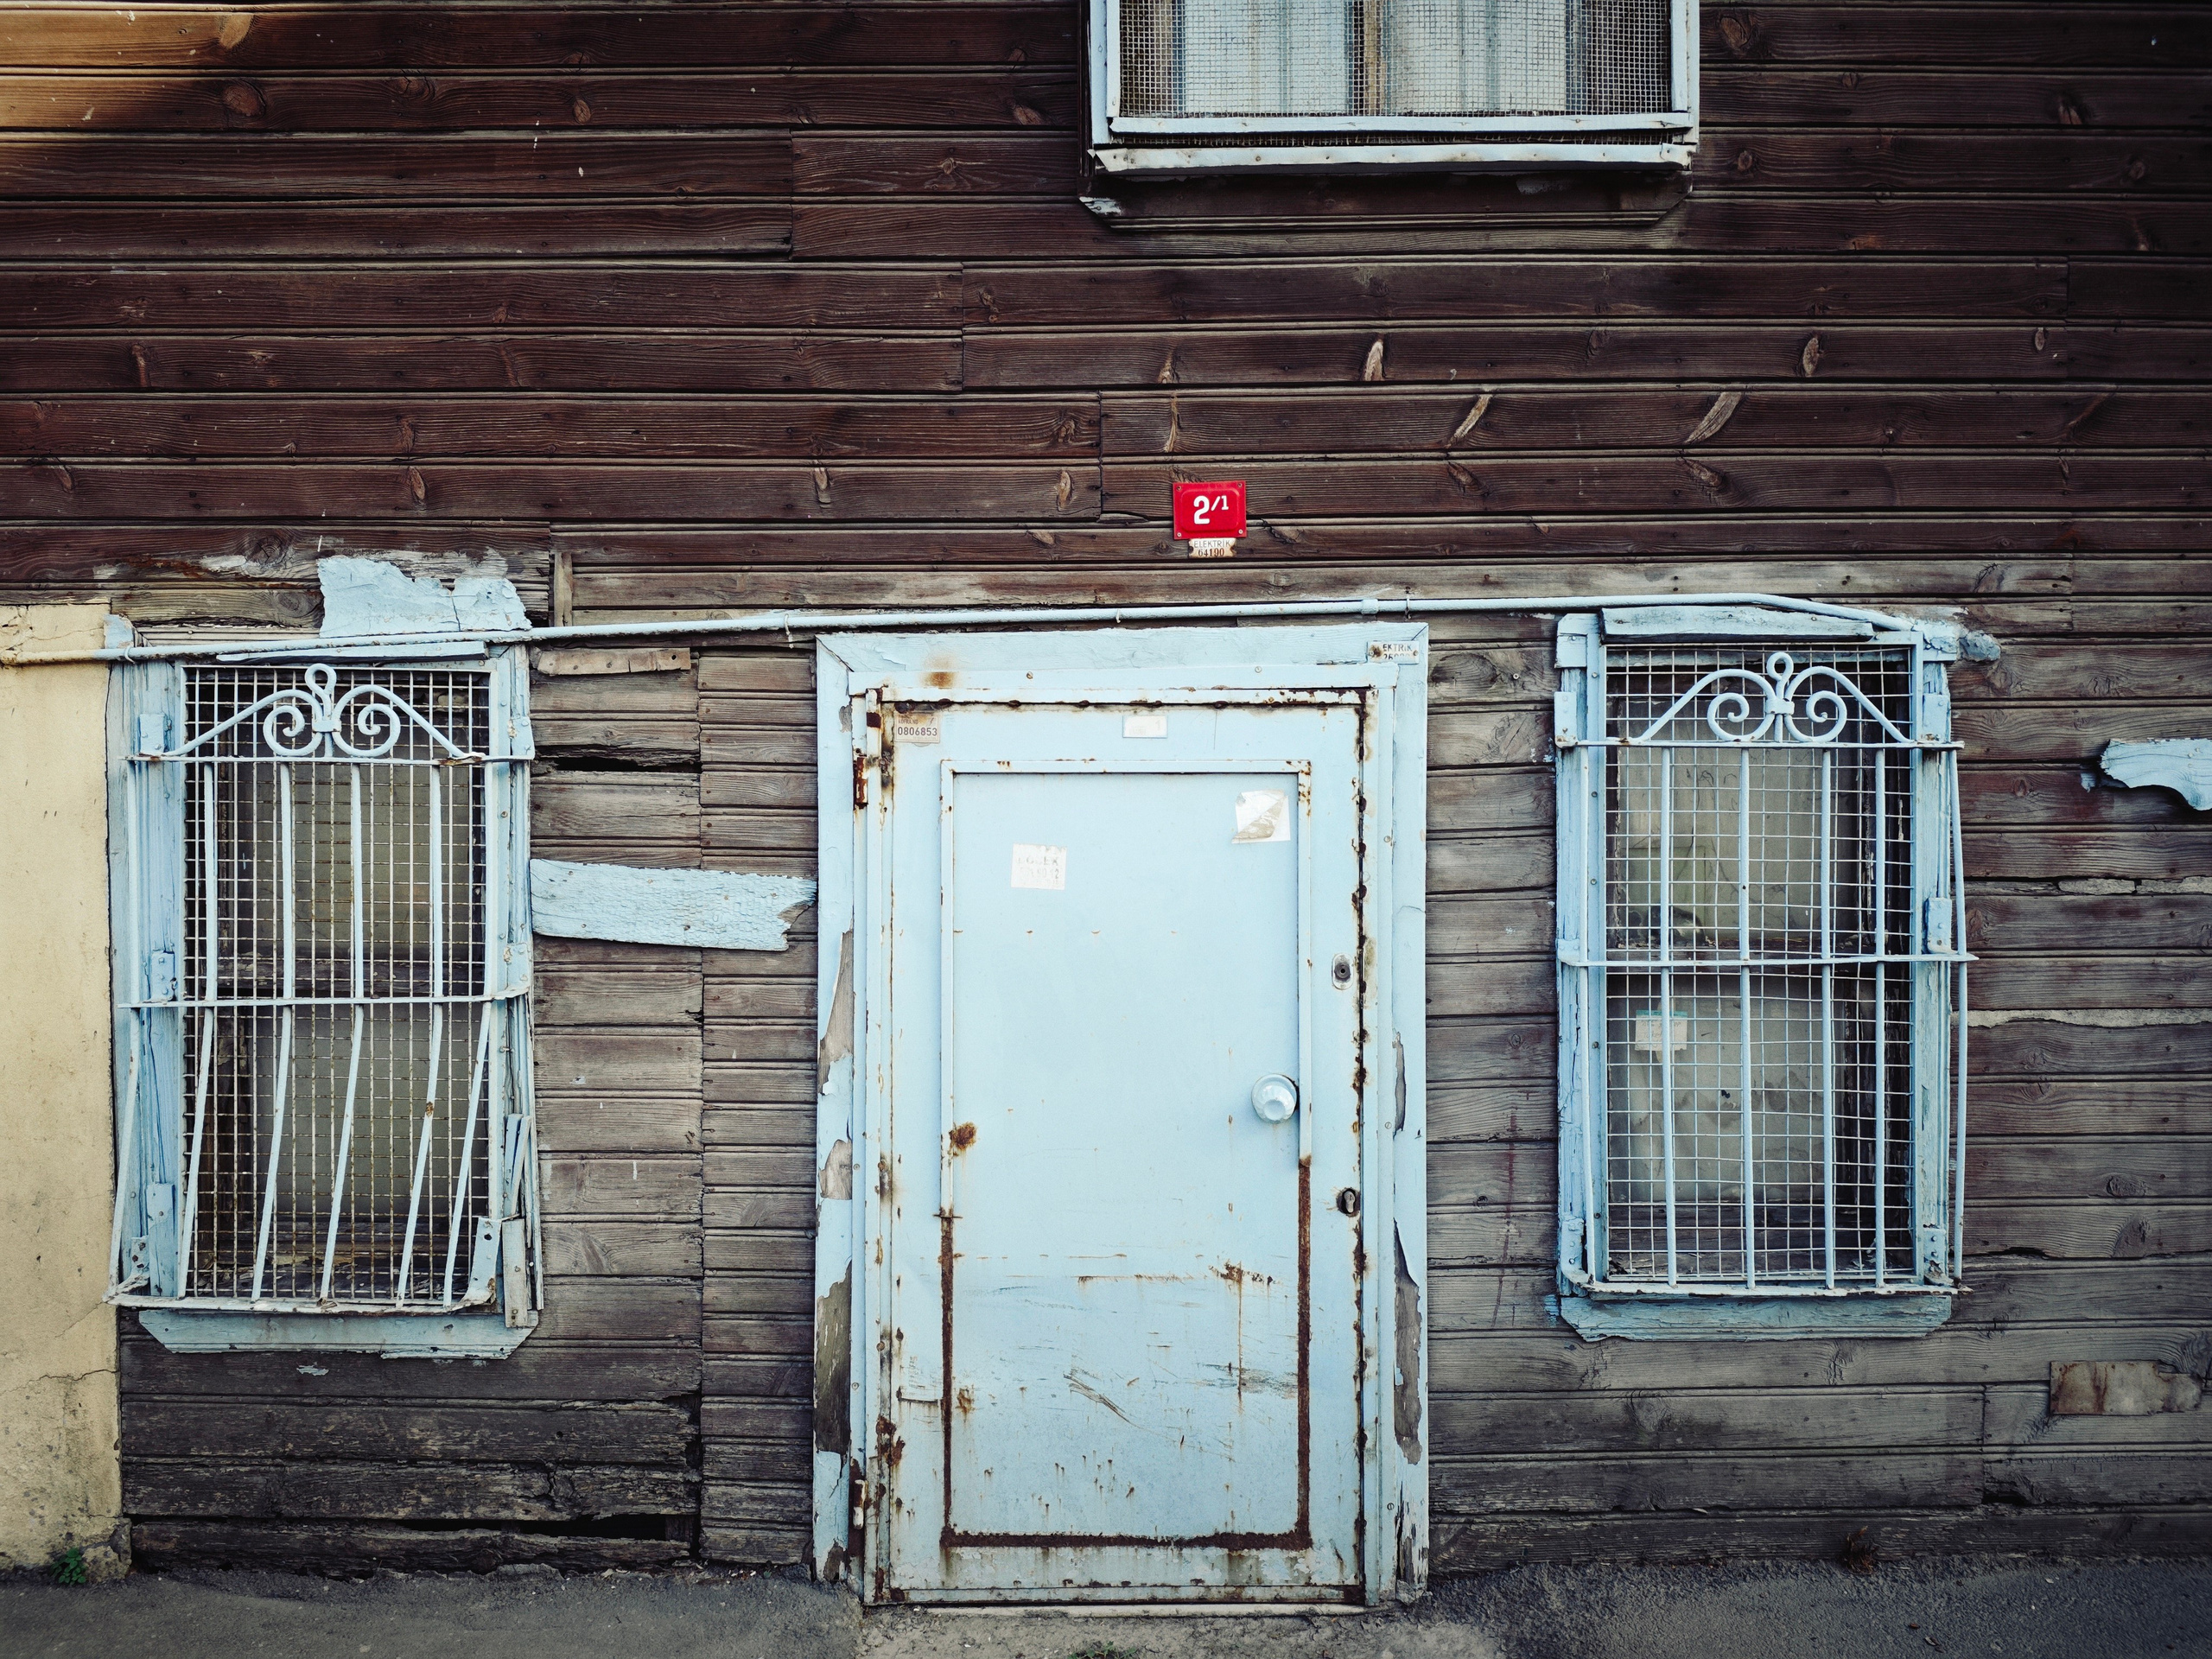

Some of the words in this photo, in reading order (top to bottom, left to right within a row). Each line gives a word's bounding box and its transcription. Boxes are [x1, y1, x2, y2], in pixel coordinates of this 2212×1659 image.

[1193, 494, 1230, 524] 2/1
[1193, 539, 1231, 549] ELEKTRİK
[897, 726, 938, 736] 0806853
